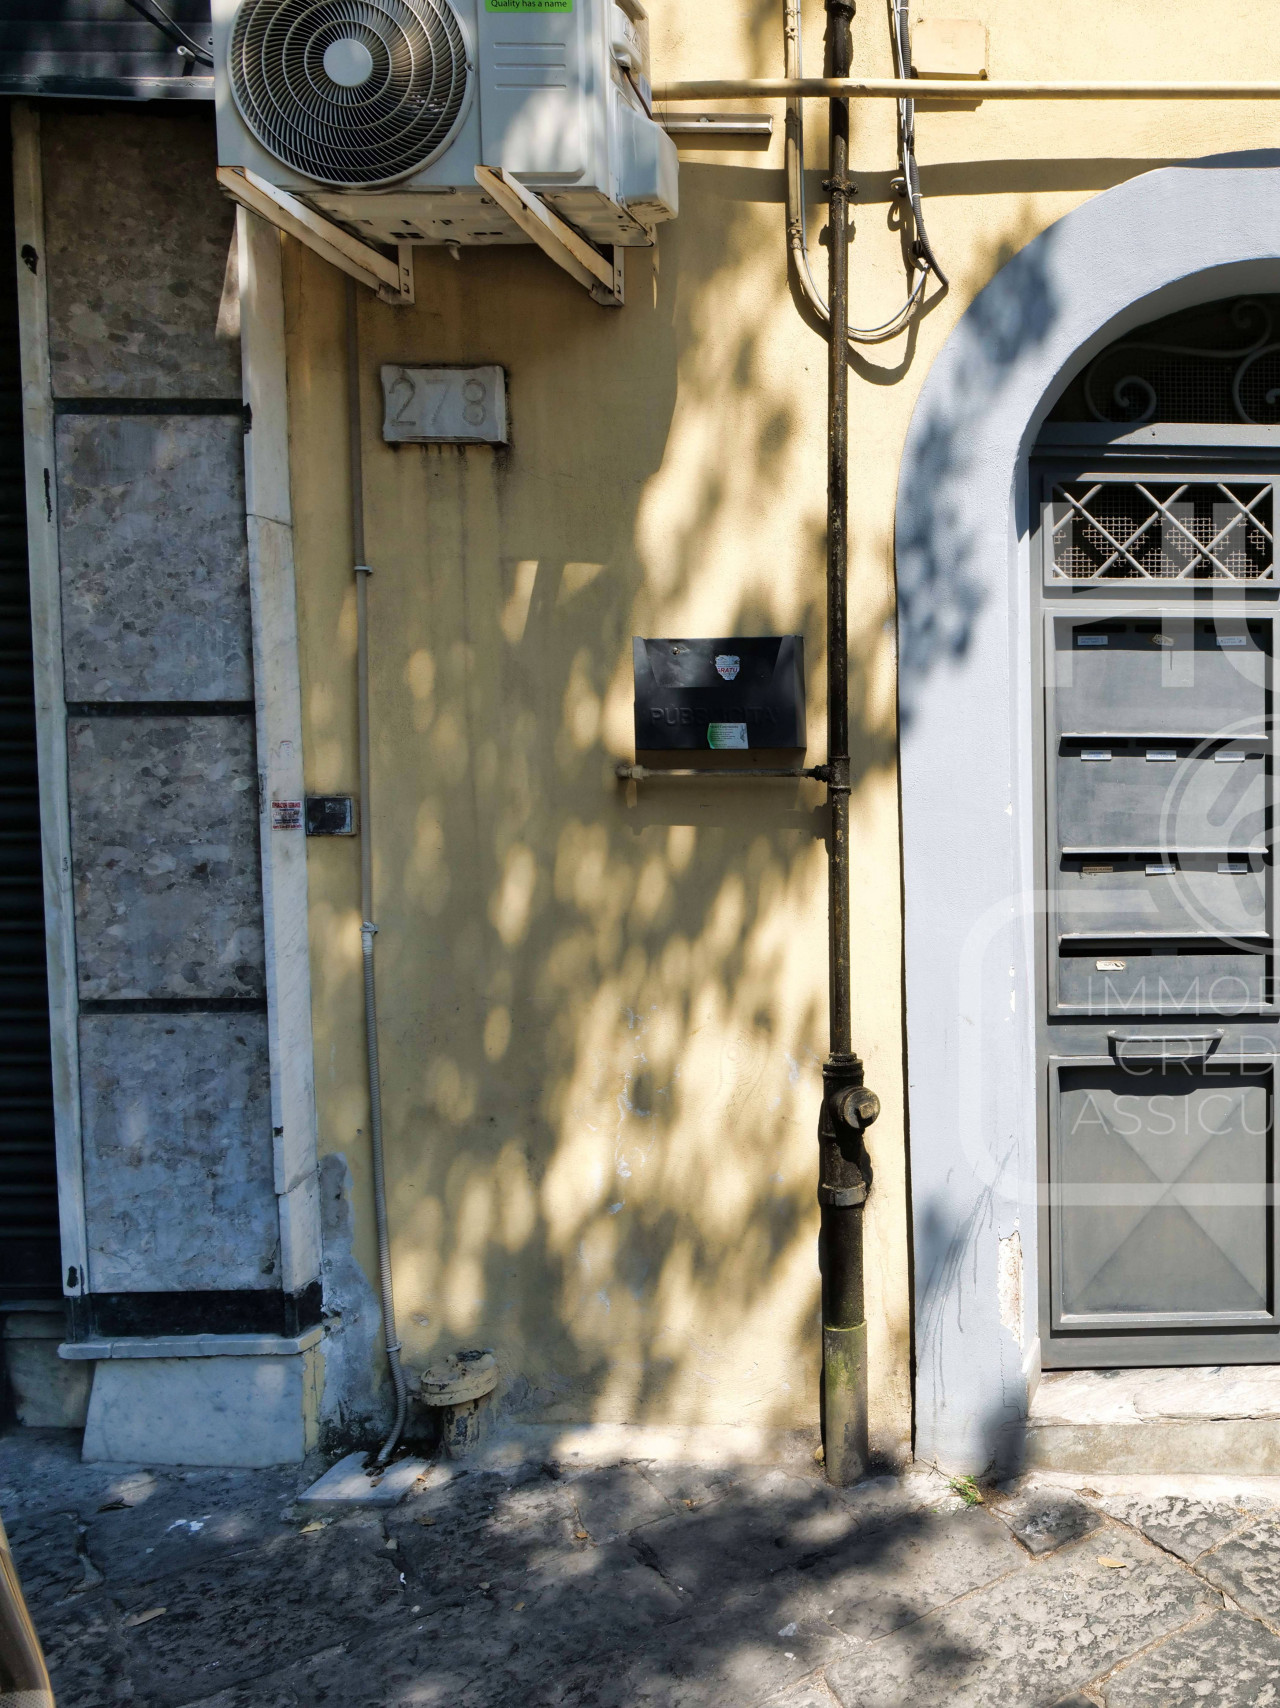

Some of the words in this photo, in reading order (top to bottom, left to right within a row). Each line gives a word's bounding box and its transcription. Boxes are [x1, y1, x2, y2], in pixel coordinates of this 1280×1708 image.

[490, 0, 519, 8] Quality
[522, 0, 536, 8] has
[389, 377, 487, 427] 278
